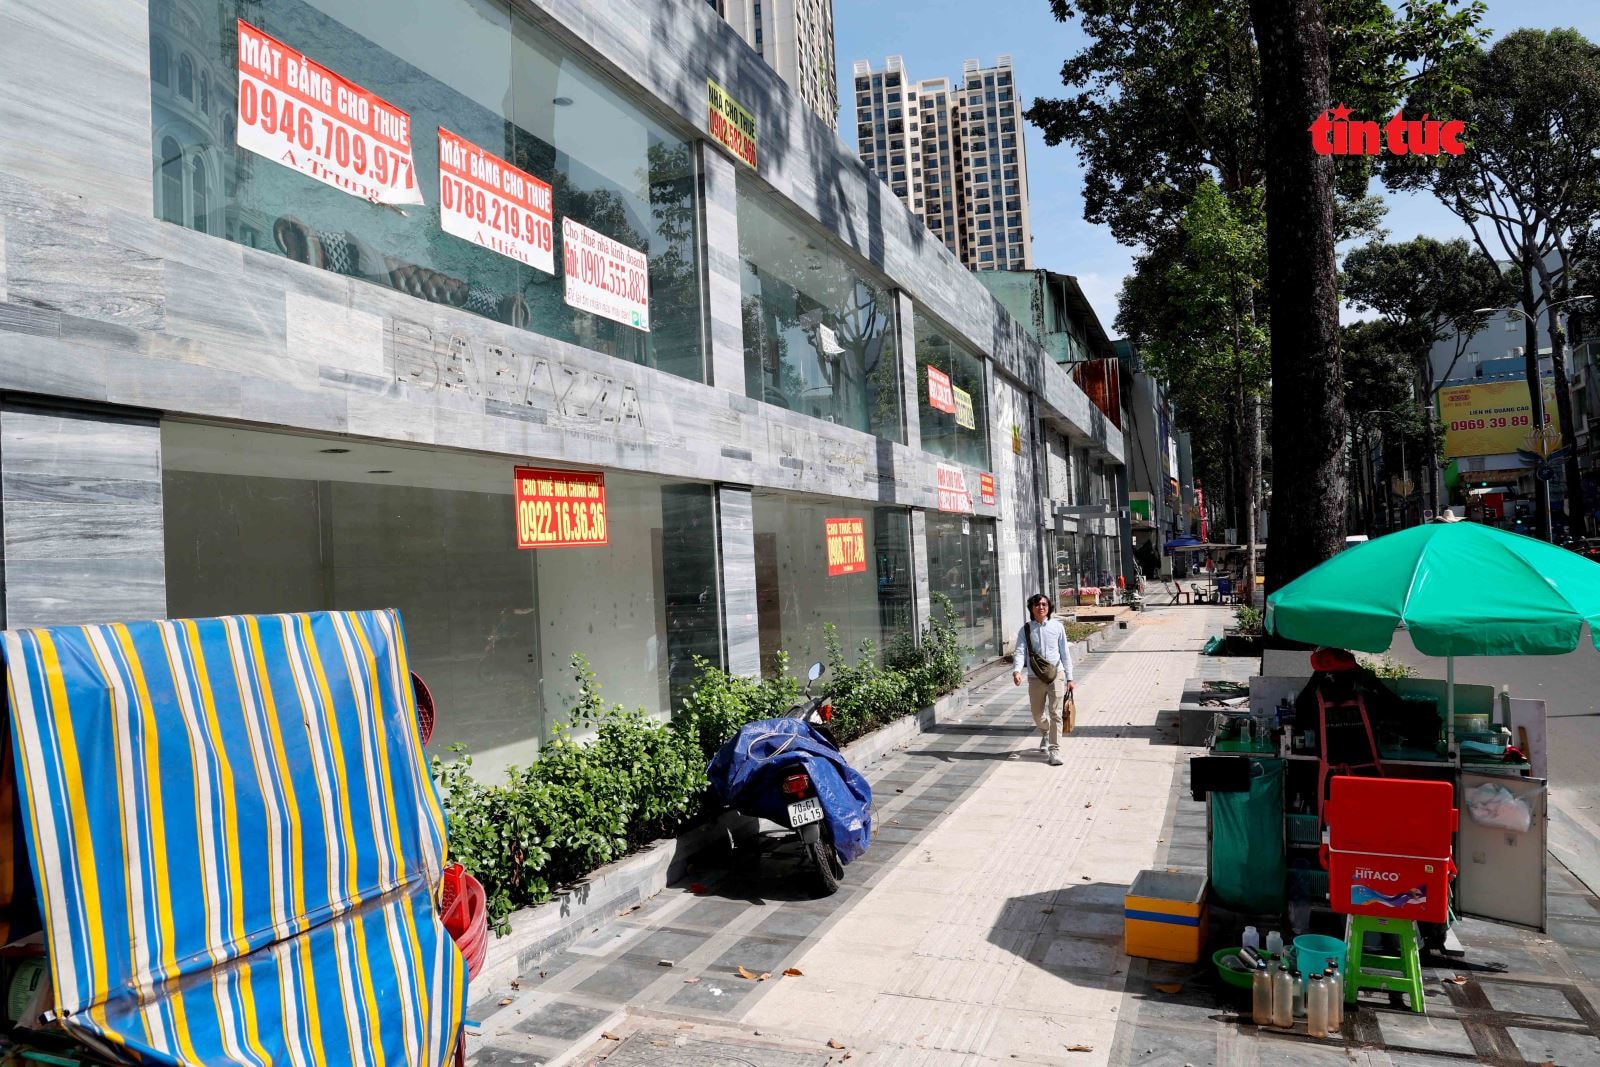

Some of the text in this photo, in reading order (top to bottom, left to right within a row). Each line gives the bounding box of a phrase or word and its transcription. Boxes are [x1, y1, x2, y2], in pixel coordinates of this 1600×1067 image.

[240, 32, 409, 147] MẶT BẰNG CHO THUÊ
[708, 84, 756, 139] NHÀ CHO THUÊ
[240, 79, 414, 190] 0946.709.977
[440, 137, 551, 214] MẶT BẰNG CHO THUÊ
[442, 175, 551, 253] 0789.219.919
[564, 220, 579, 239] Cho
[610, 241, 625, 262] kinh
[625, 251, 646, 270] doanh
[522, 478, 537, 496] CHO
[537, 475, 554, 497] THUÊ
[554, 476, 568, 497] NHÀ
[568, 477, 587, 498] CHÍNH
[519, 500, 605, 543] 0922.16.36.36
[1355, 869, 1399, 882] HITACO
